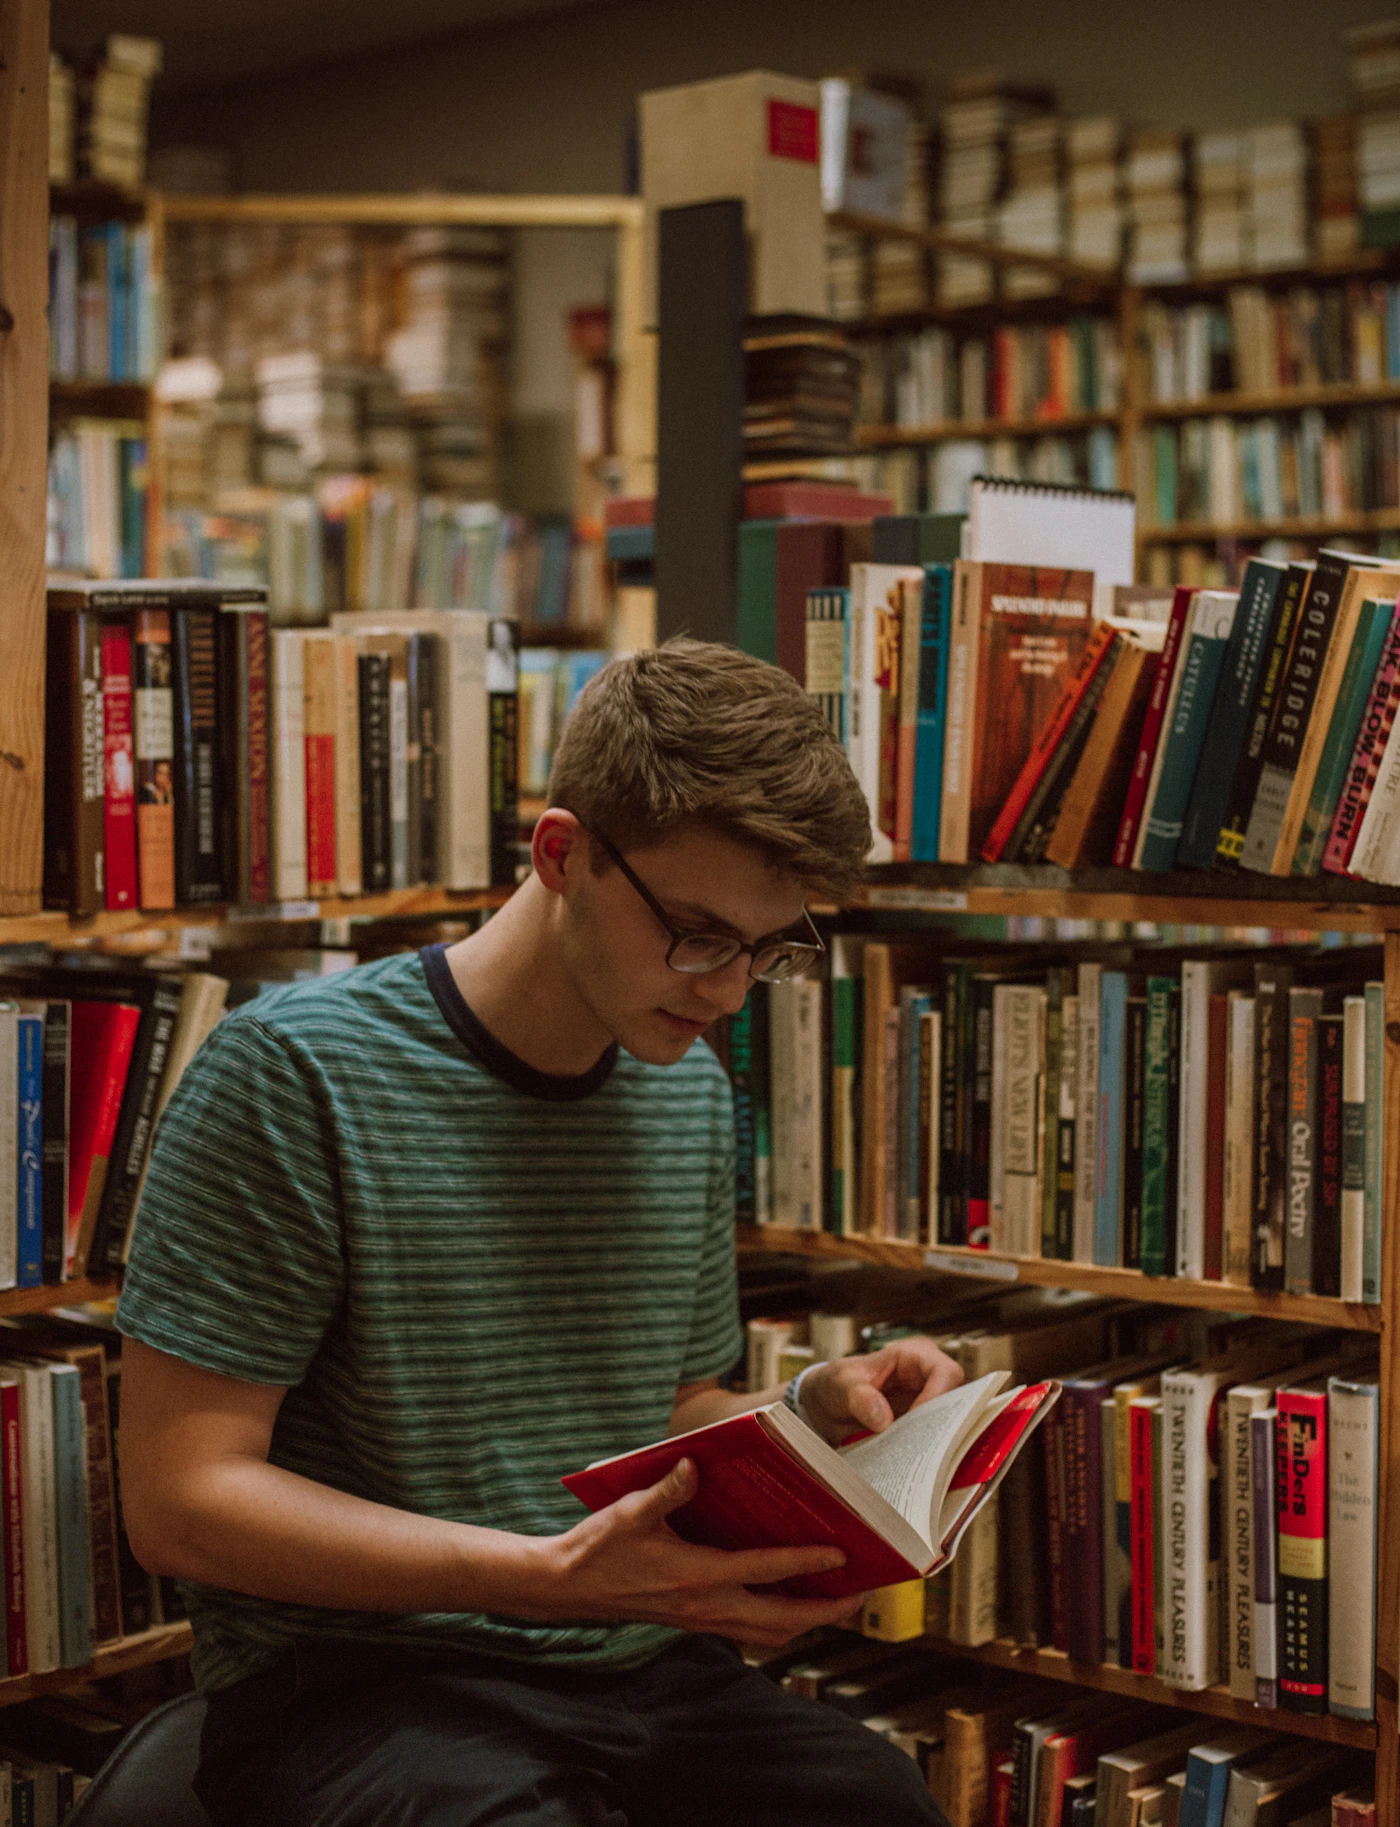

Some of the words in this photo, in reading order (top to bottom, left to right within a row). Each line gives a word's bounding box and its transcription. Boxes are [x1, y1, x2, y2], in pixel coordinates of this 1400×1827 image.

[249, 619, 266, 678] ANNE
[1277, 590, 1330, 748] COLERIDGE
[1174, 641, 1204, 734] CATULLUS
[1358, 681, 1391, 756] BLOW,
[249, 689, 267, 780] SEXTON
[1336, 765, 1368, 841] BURN
[126, 1115, 149, 1176] ACHILLES
[1291, 1121, 1311, 1168] Oral
[1323, 1063, 1339, 1151] SURPRISED
[1289, 1169, 1311, 1239] Poetry
[1322, 1181, 1337, 1207] SIN
[1323, 1154, 1338, 1177] BY
[1170, 1405, 1187, 1494] TWENTIETH
[1236, 1411, 1250, 1499] TWENTIETH
[1170, 1501, 1186, 1571] CENTURY
[1236, 1507, 1250, 1577] CENTURY
[1171, 1577, 1187, 1664] PLEASURES
[1236, 1583, 1250, 1670] PLEASURES
[1285, 1590, 1296, 1671] HEANEY
[1298, 1593, 1309, 1672] SEAMUS
